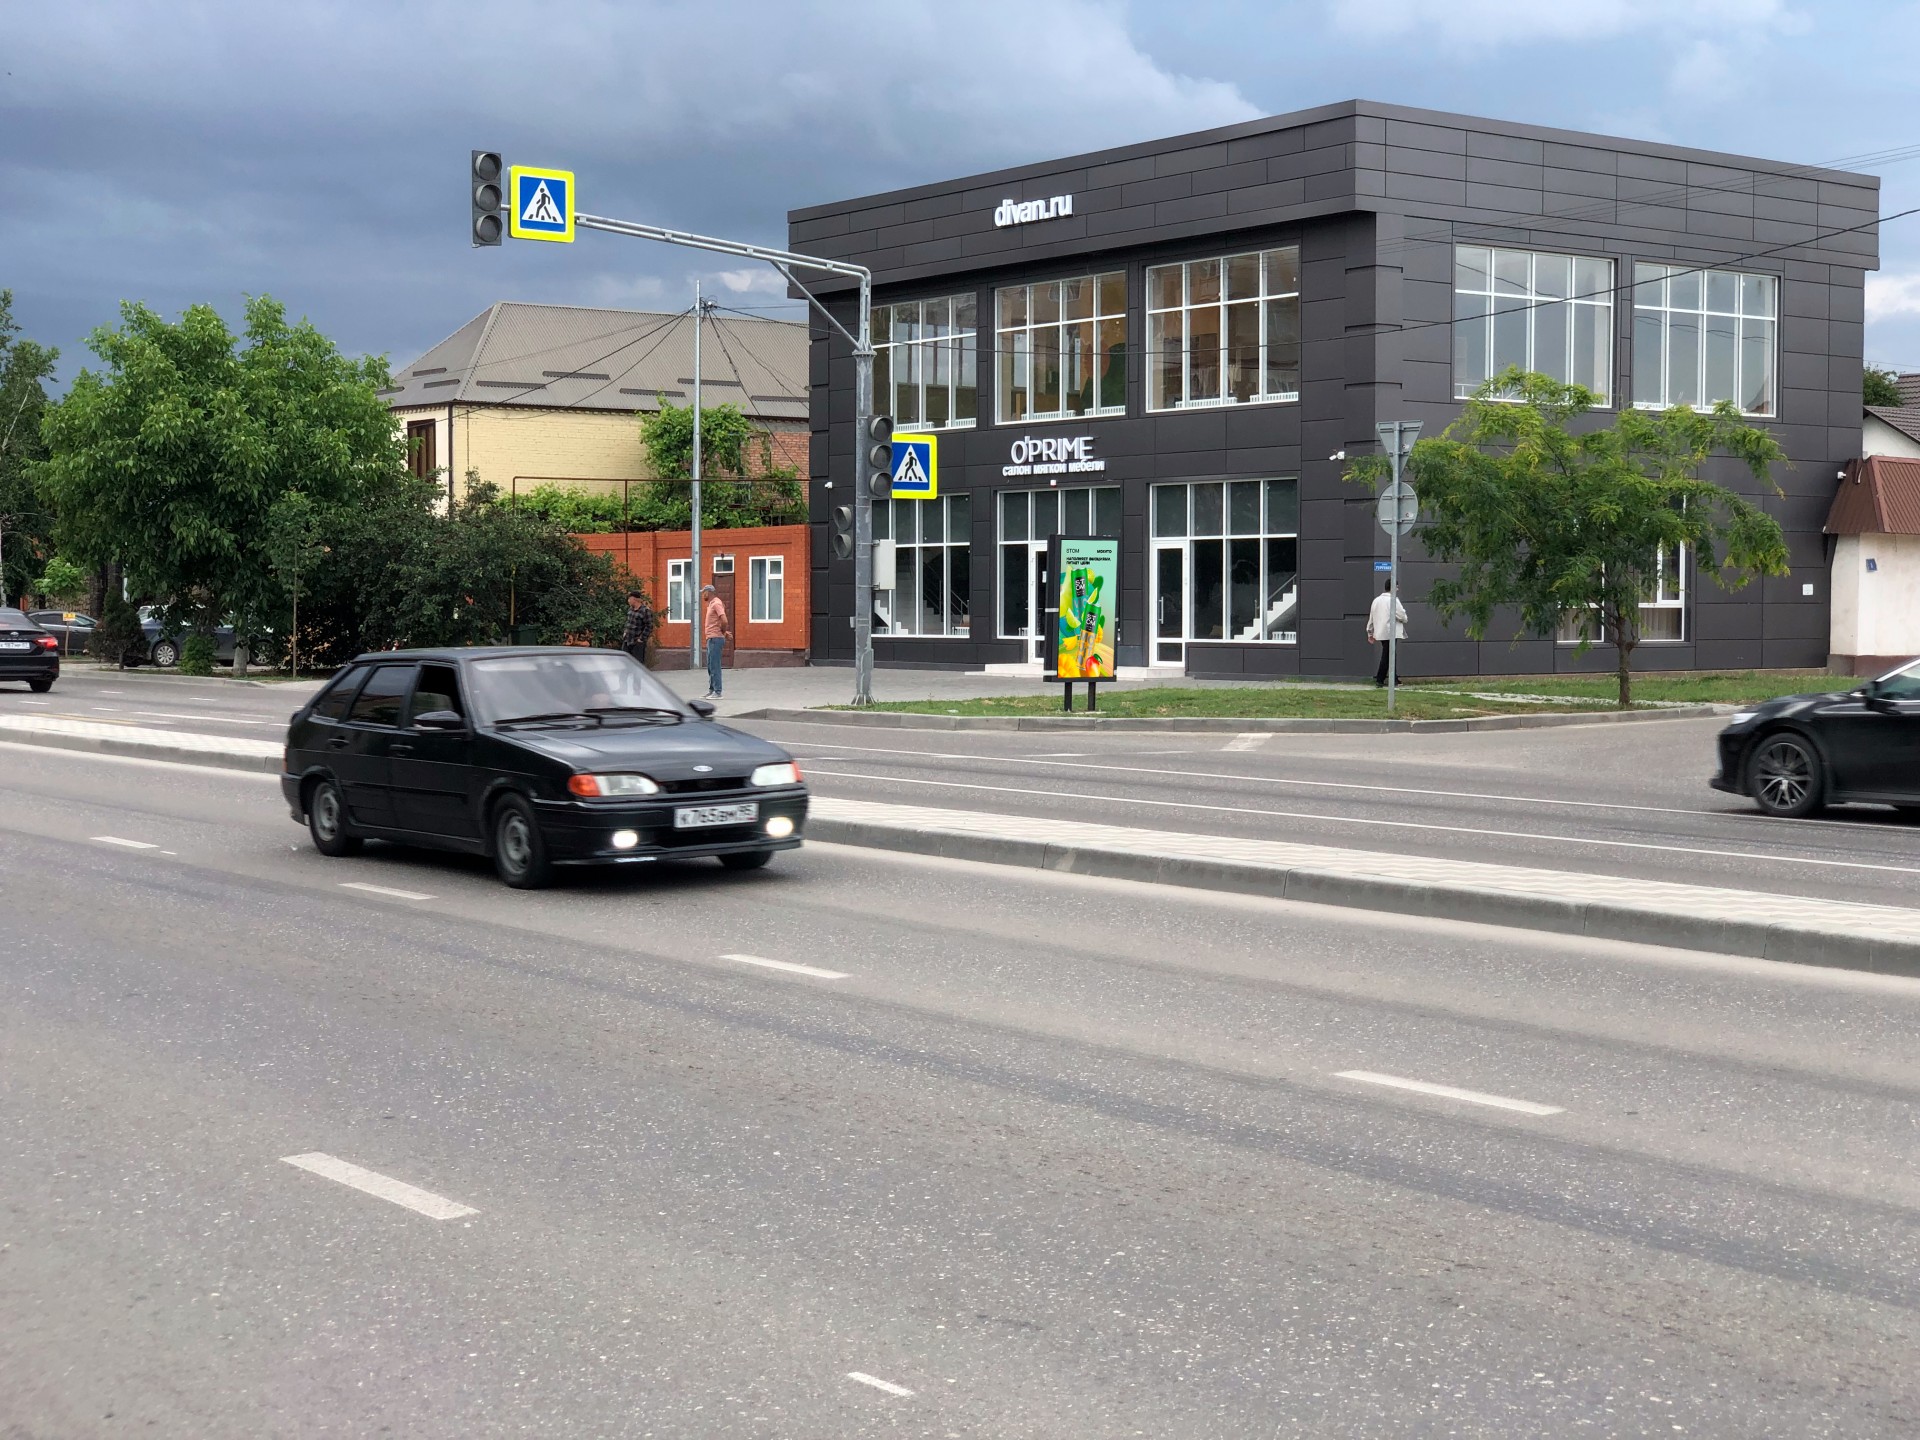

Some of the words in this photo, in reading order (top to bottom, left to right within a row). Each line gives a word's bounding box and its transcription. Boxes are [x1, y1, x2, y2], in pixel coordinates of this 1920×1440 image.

[994, 194, 1073, 227] divan.ru
[1002, 465, 1032, 476] салон
[1033, 461, 1067, 475] мягкой
[1068, 460, 1105, 473] мебели
